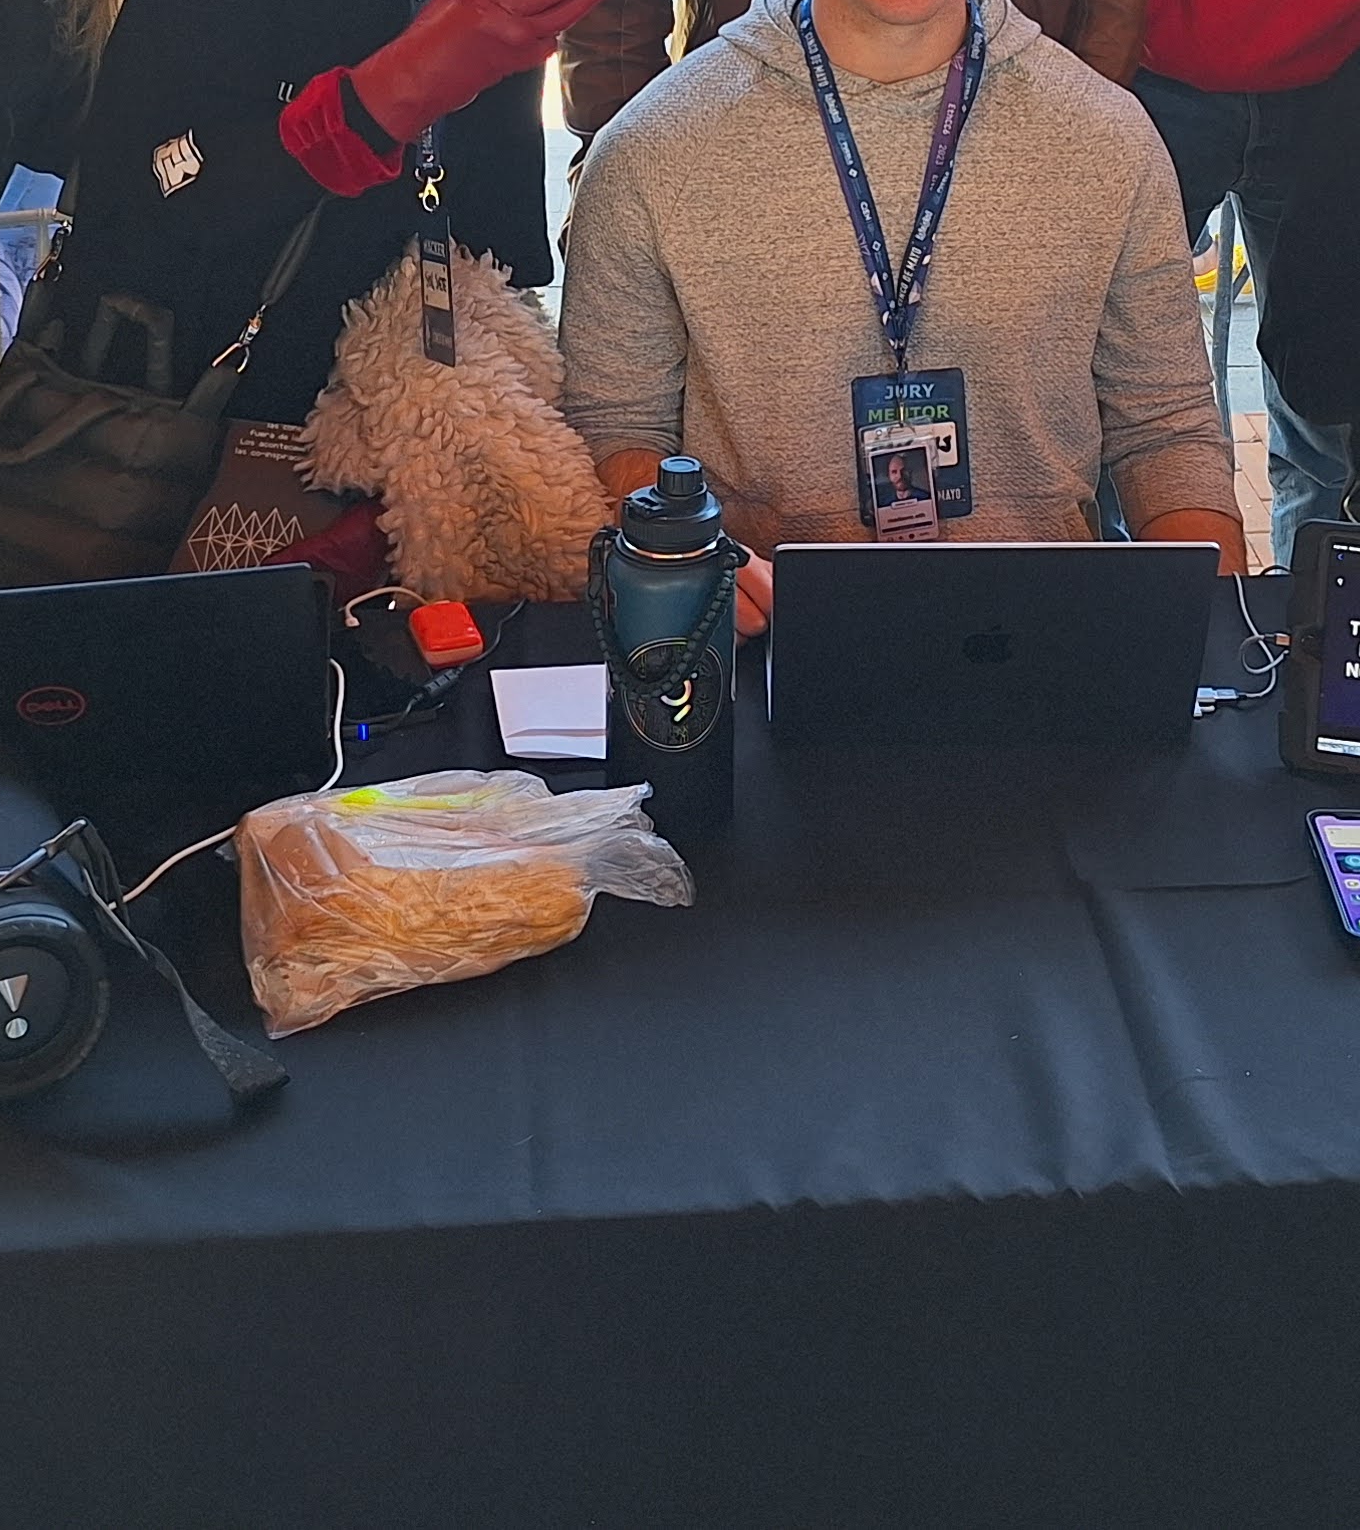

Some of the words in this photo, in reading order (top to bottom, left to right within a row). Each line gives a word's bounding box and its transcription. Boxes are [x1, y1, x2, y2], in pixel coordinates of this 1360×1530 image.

[804, 32, 819, 54] CINCO
[810, 53, 822, 65] DE
[813, 64, 829, 88] MAYO
[906, 246, 923, 271] MAYO
[904, 267, 914, 284] DE
[884, 383, 935, 401] JURY
[868, 404, 950, 423] MENTOR
[26, 699, 80, 713] DELL
